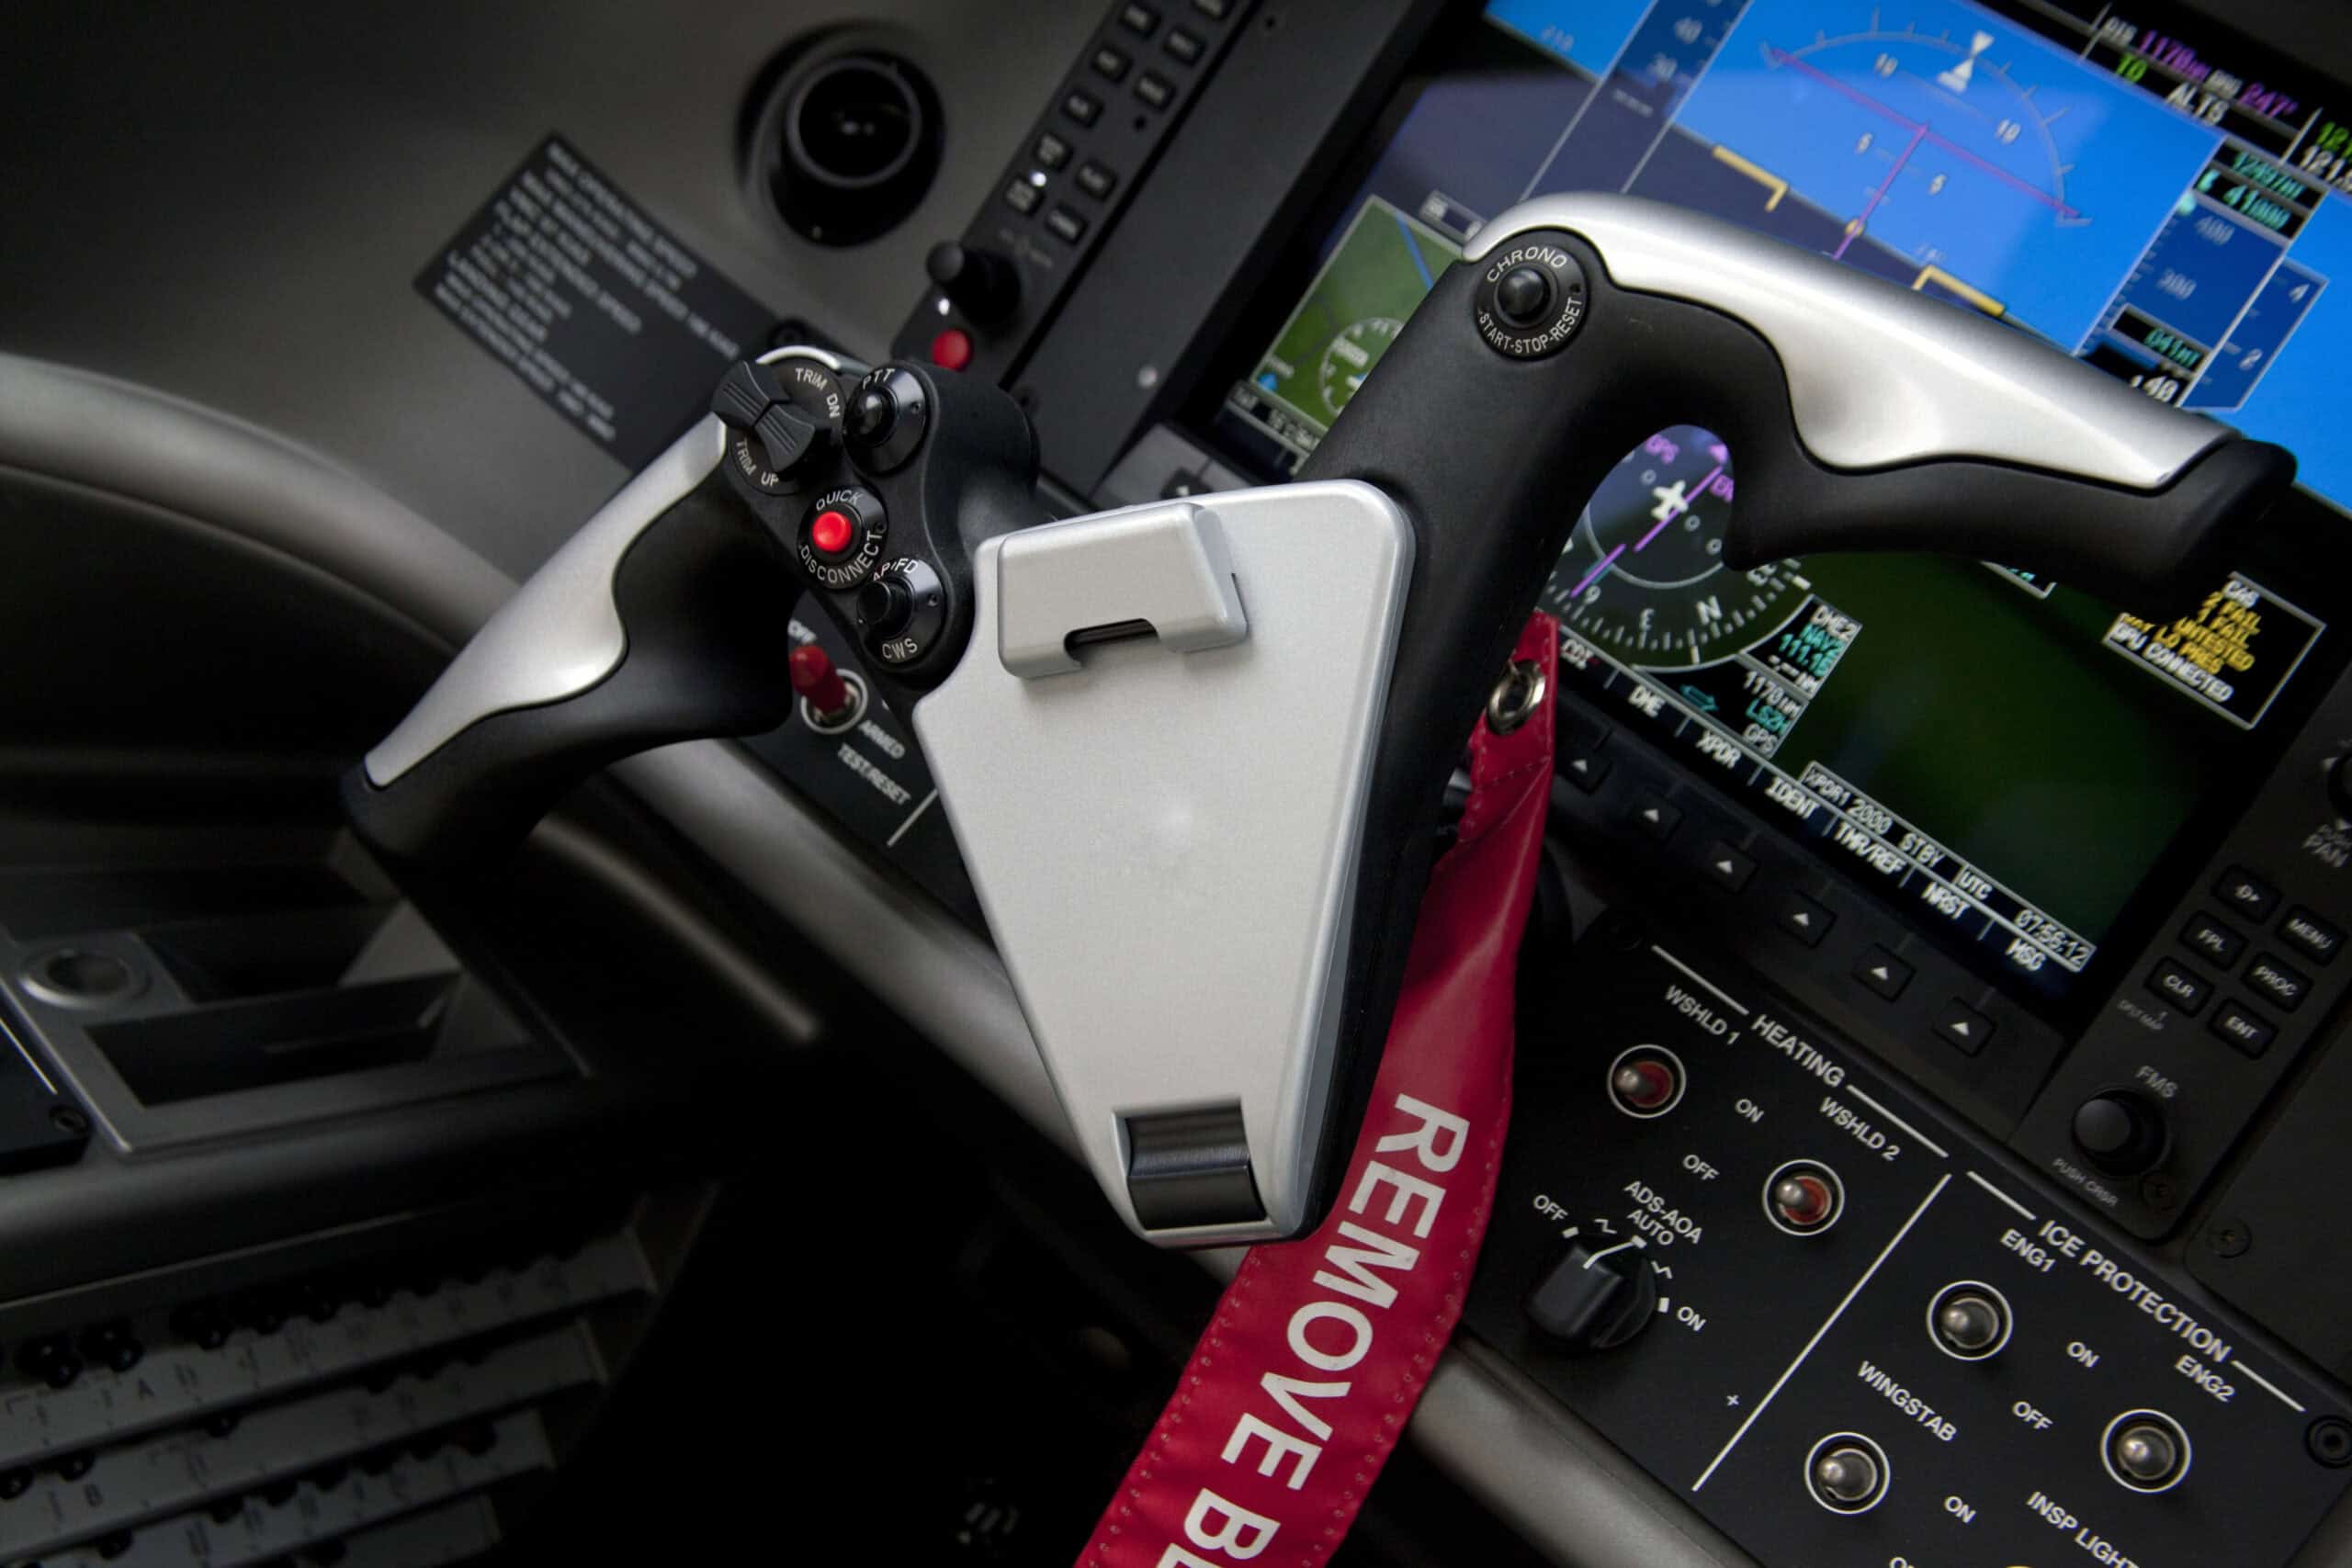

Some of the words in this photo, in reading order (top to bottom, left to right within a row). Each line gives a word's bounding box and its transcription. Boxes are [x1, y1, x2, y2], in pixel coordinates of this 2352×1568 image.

[1487, 246, 1567, 282] CHRONO
[1479, 297, 1582, 354] START-STOP-RESET
[795, 367, 829, 390] TRIM
[826, 392, 841, 419] DN
[862, 367, 896, 390] PTT
[736, 437, 756, 477] TRIM
[760, 472, 779, 487] UP
[816, 489, 864, 511] QUICK
[799, 529, 883, 583] DISCONNECT
[1695, 595, 1723, 625] N
[881, 637, 919, 660] CWS
[2142, 642, 2235, 703] CONNECTED
[1627, 685, 1667, 717] DME
[1696, 729, 1742, 769] XPDR
[1765, 776, 1821, 820] IDENT
[1835, 820, 1906, 874] TMR/REF
[1846, 797, 1894, 835] 2000
[1898, 831, 1945, 869] STBY
[1920, 879, 1972, 919] NRST
[1959, 869, 1994, 901] UTC
[2197, 928, 2226, 953] FPL
[2285, 917, 2334, 950] MENU
[2005, 938, 2048, 972] MSG
[2162, 973, 2197, 999] CLR
[2252, 964, 2299, 998] PROC
[1665, 985, 1729, 1036] WSHLD
[1726, 1030, 1742, 1045] 1
[2224, 1013, 2260, 1041] ENT
[1751, 1013, 1846, 1089] HEATING
[2134, 1064, 2179, 1100] FMS
[1735, 1098, 1765, 1123] ON
[1819, 1096, 1886, 1152] WSHLD
[1882, 1145, 1902, 1163] 2
[1682, 1153, 1721, 1184] OFF
[1532, 1194, 1569, 1223] OFF
[1623, 1179, 1703, 1245] ADS-AOA
[1627, 1208, 1676, 1247] AUTO
[2000, 1228, 2057, 1274] ENG1
[1221, 1093, 1470, 1491] REMOVE
[2037, 1219, 2086, 1258] ICE
[2081, 1247, 2233, 1363] PROTECTION
[1677, 1305, 1707, 1333] ON
[2065, 1340, 2101, 1369] ON
[2175, 1354, 2236, 1404] ENG2
[1857, 1359, 1958, 1442] WINGSTAB
[2012, 1399, 2054, 1432] OFF
[1943, 1495, 1977, 1524] ON
[2026, 1491, 2079, 1530] INSP
[2075, 1527, 2140, 1568] LIGH
